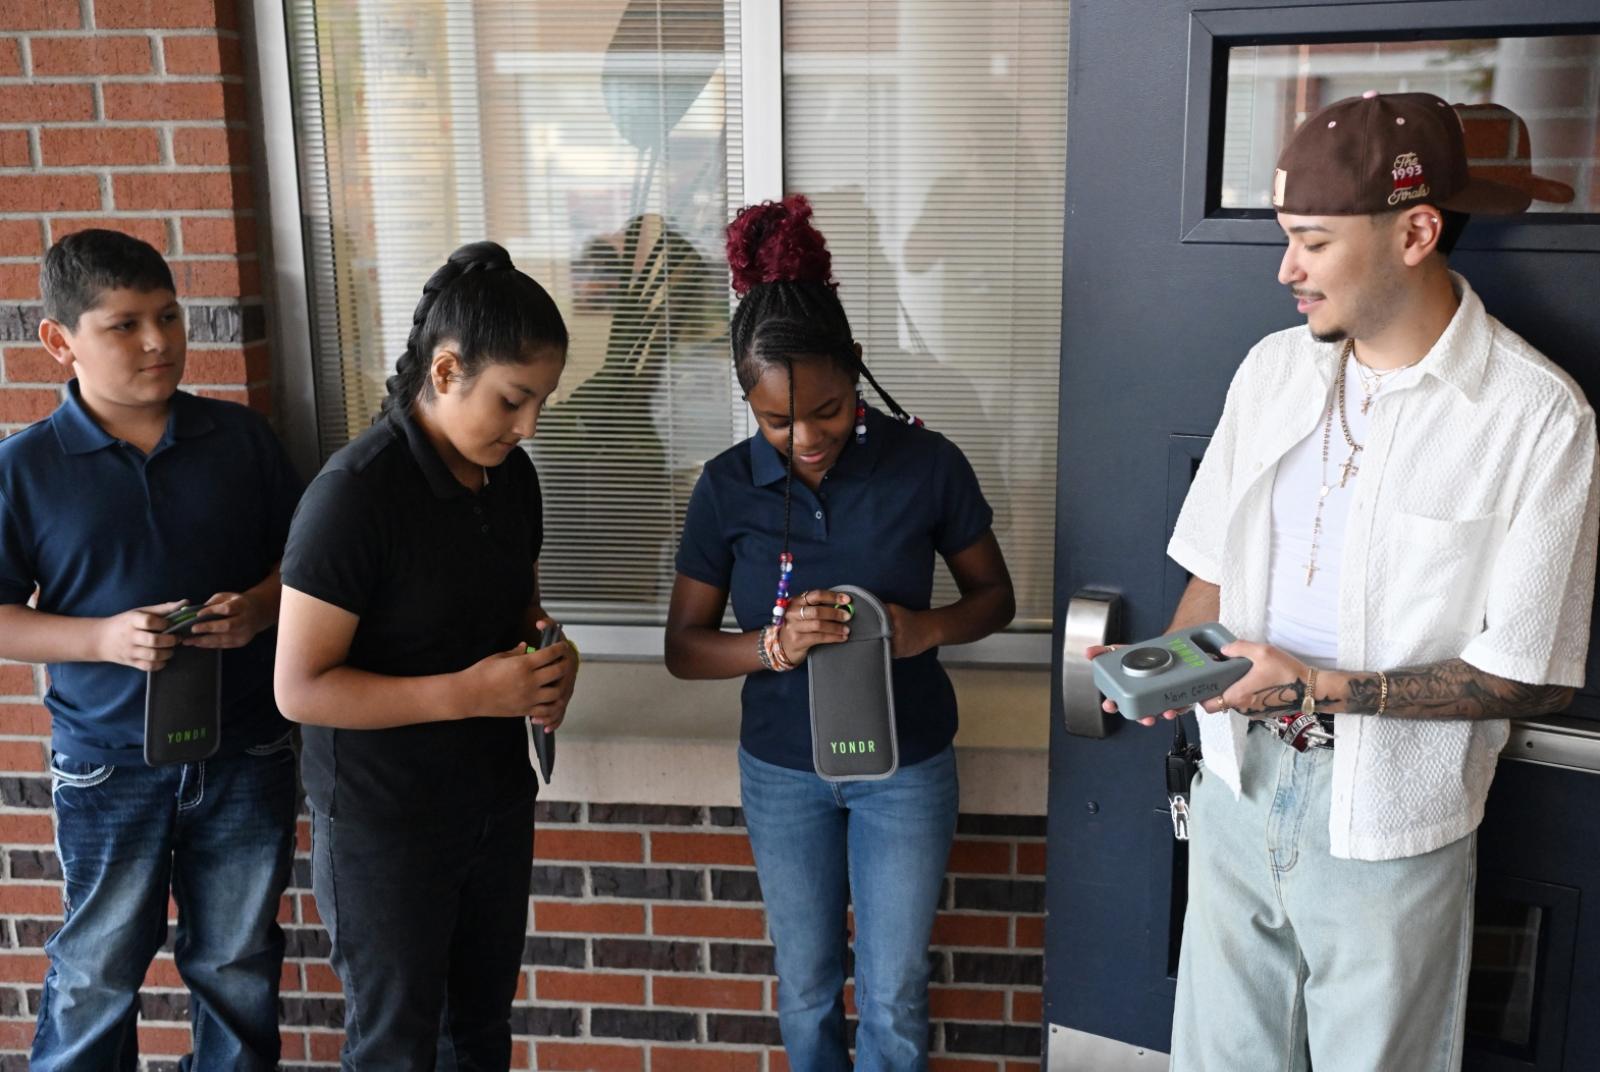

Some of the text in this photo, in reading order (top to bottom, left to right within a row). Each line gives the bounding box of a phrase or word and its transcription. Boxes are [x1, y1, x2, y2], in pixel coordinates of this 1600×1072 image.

[1393, 152, 1418, 169] The
[1391, 164, 1422, 180] 1993
[1387, 183, 1430, 205] Finals
[829, 740, 876, 754] YONDR
